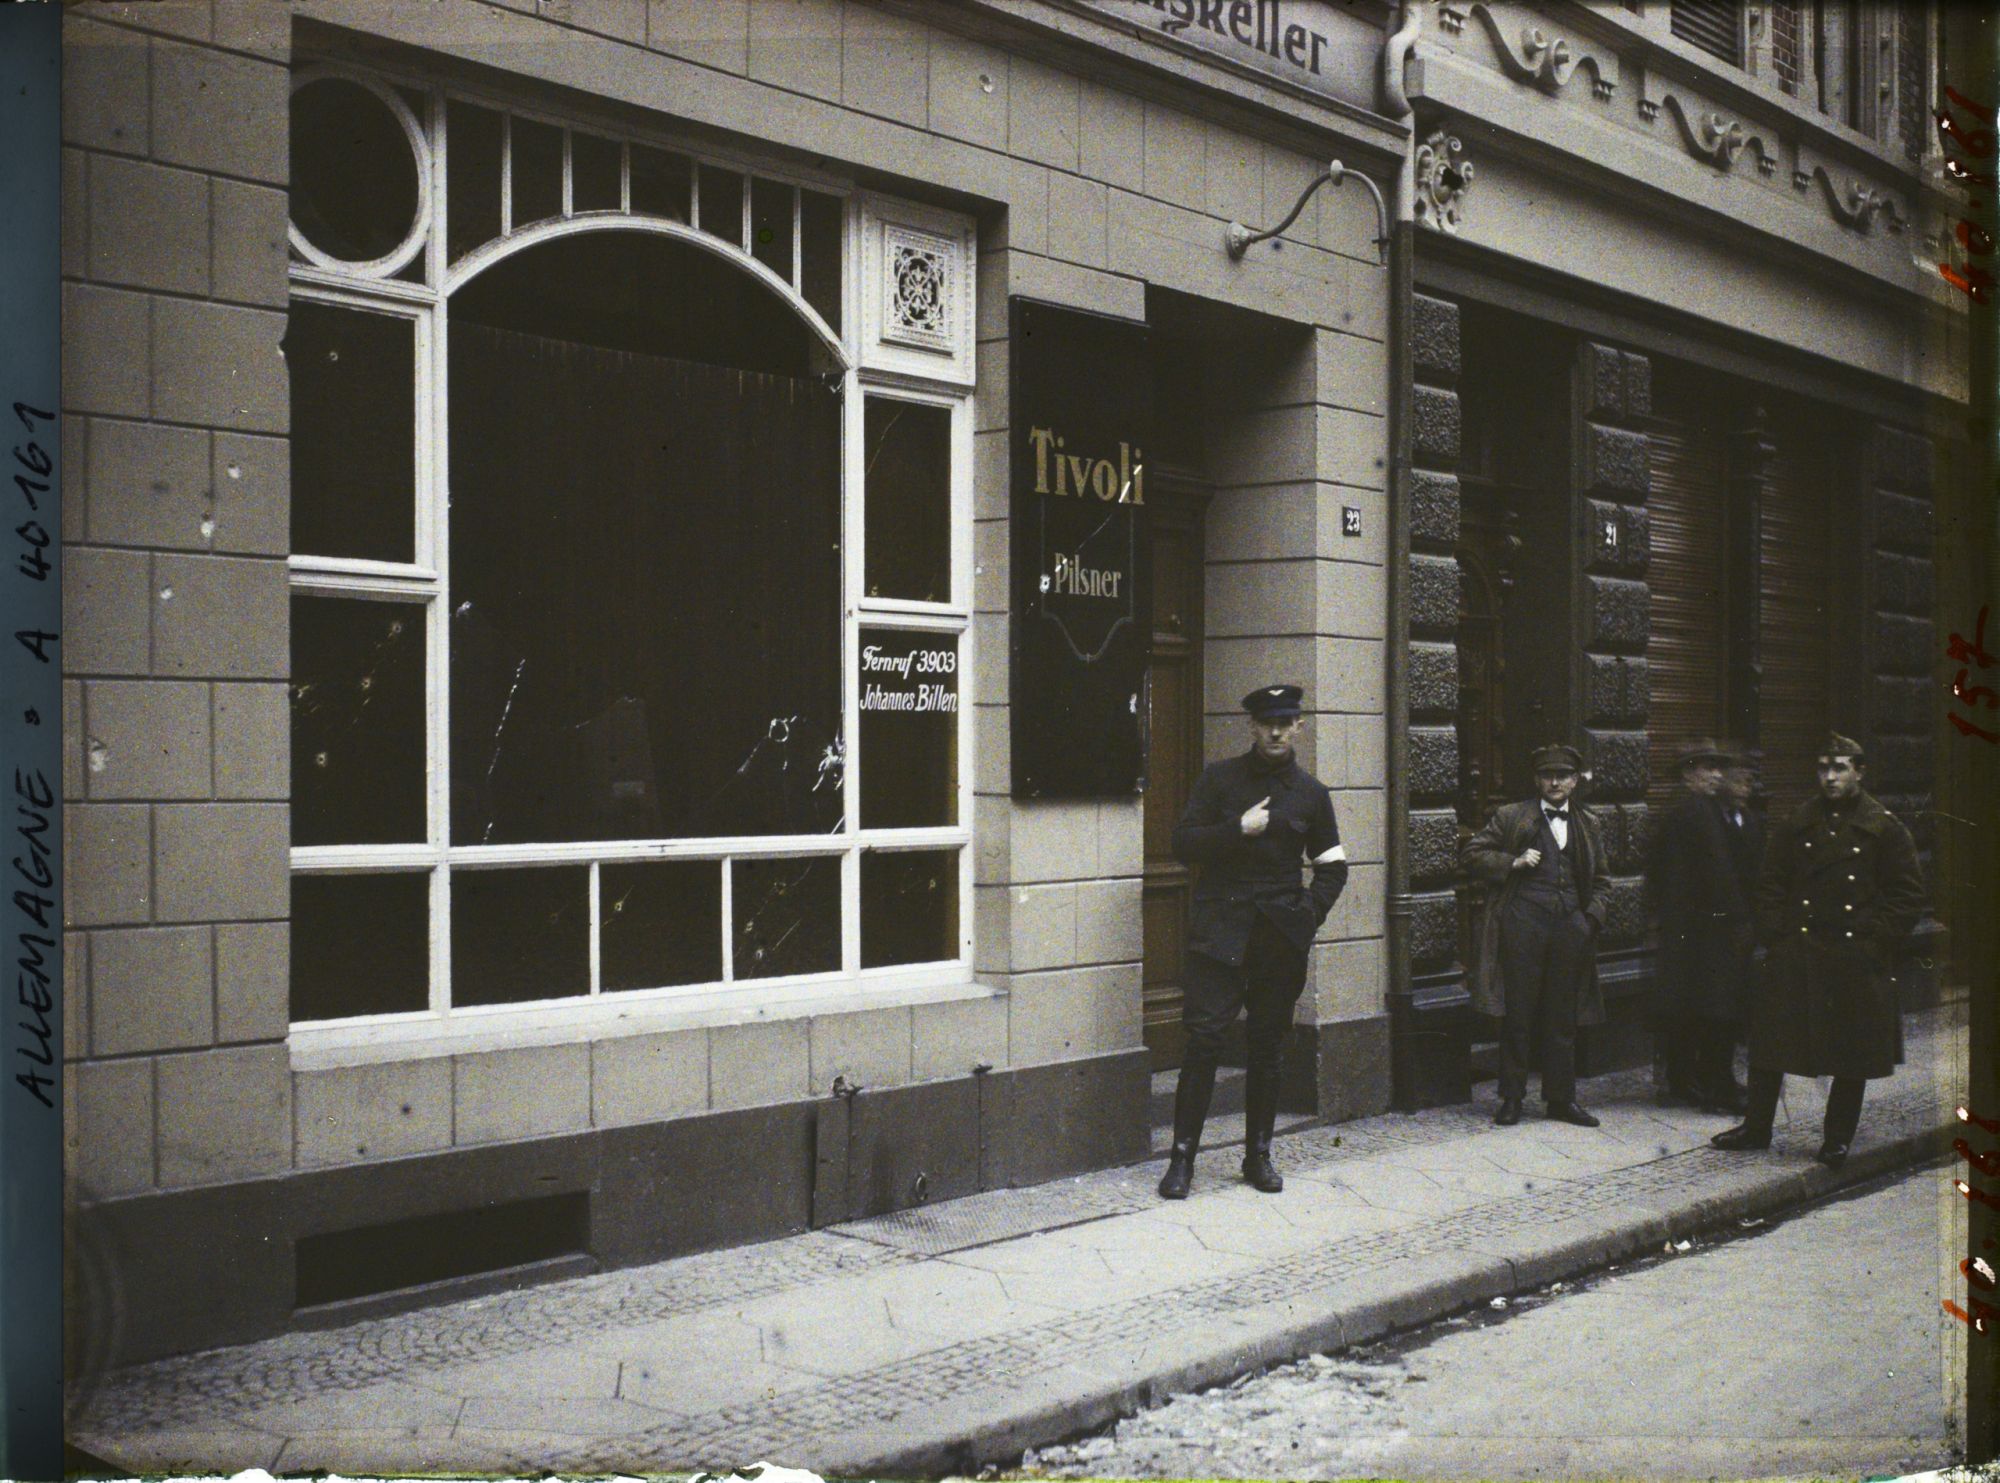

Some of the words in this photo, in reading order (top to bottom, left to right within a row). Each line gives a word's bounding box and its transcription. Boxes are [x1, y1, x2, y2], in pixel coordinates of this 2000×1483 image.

[1029, 425, 1145, 505] Tivoli
[1346, 510, 1360, 532] 23
[1605, 521, 1617, 546] 21
[1053, 552, 1122, 598] Pilsner
[861, 645, 918, 680] Fernruf
[916, 650, 956, 673] 3903
[860, 683, 916, 711] Johannes
[914, 683, 958, 713] Billen
